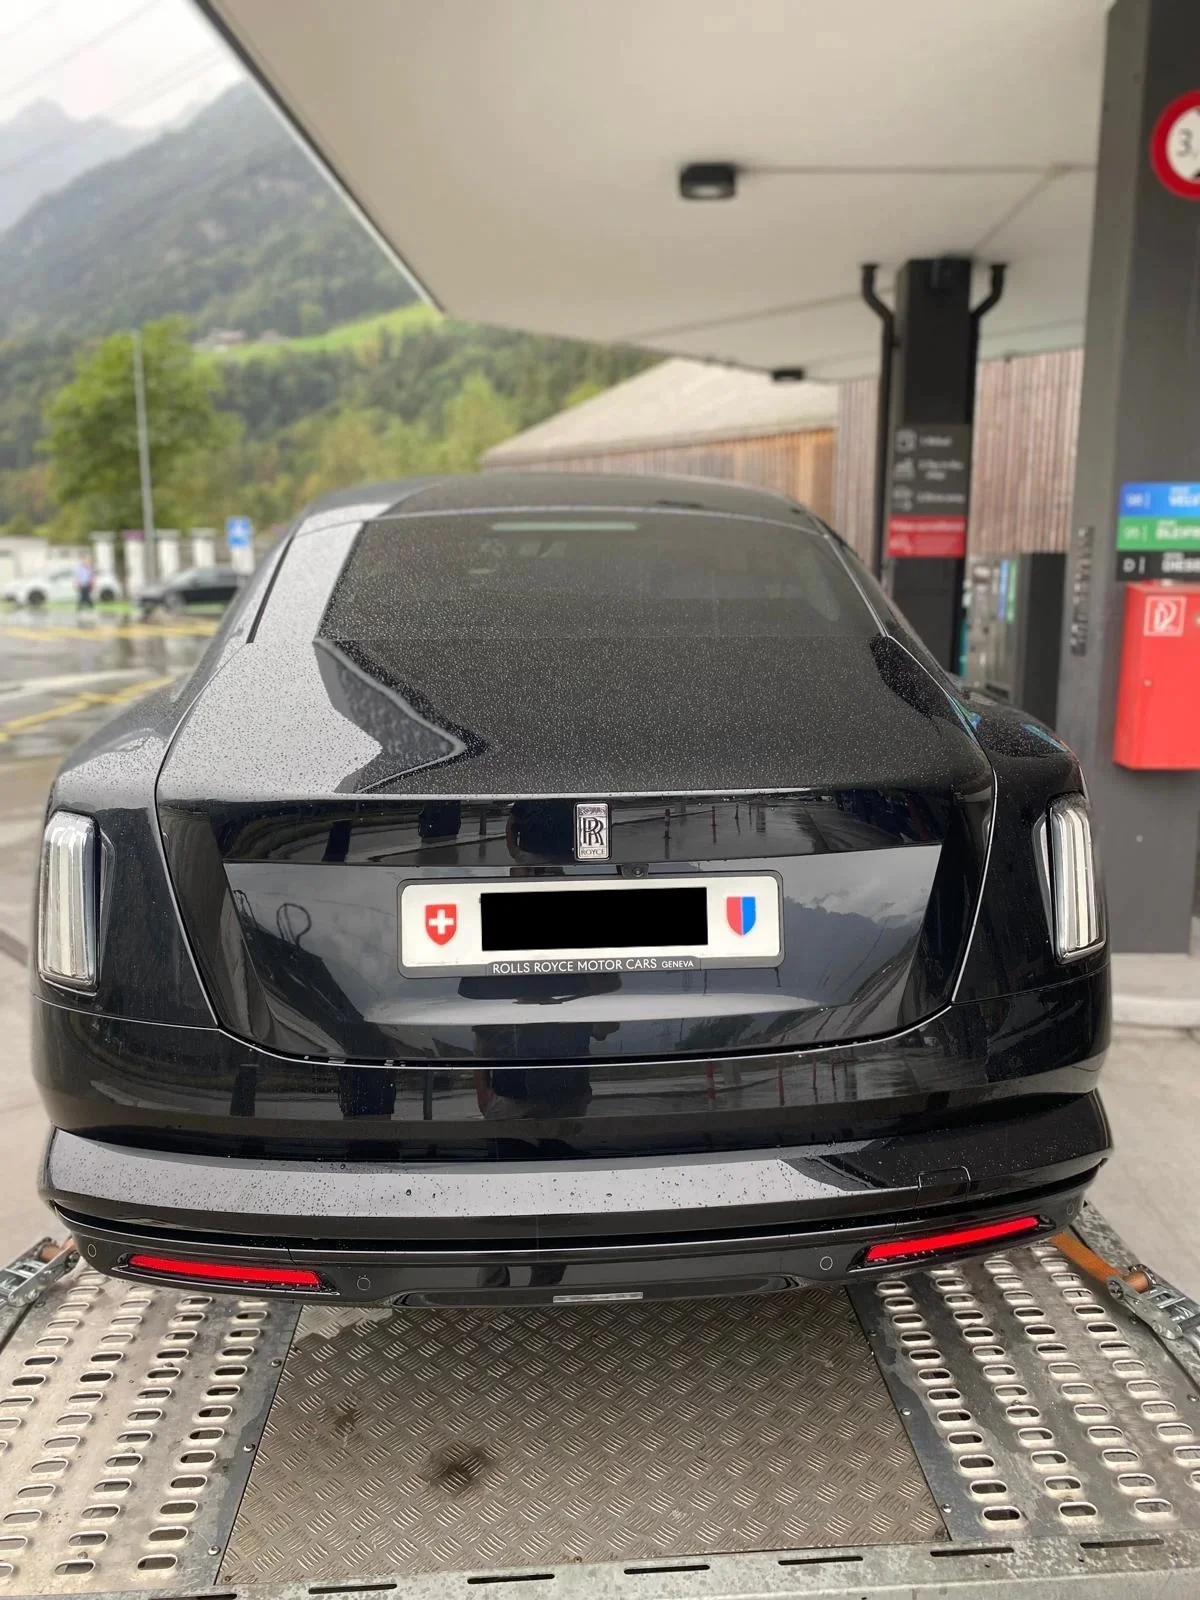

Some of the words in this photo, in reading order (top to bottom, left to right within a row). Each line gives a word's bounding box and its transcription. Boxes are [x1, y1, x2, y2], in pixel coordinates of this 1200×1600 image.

[492, 962, 530, 974] ROLLS
[534, 961, 574, 973] ROYCE
[577, 959, 623, 971] MOTOR
[625, 958, 657, 970] CARS
[661, 960, 694, 968] GENEVA
